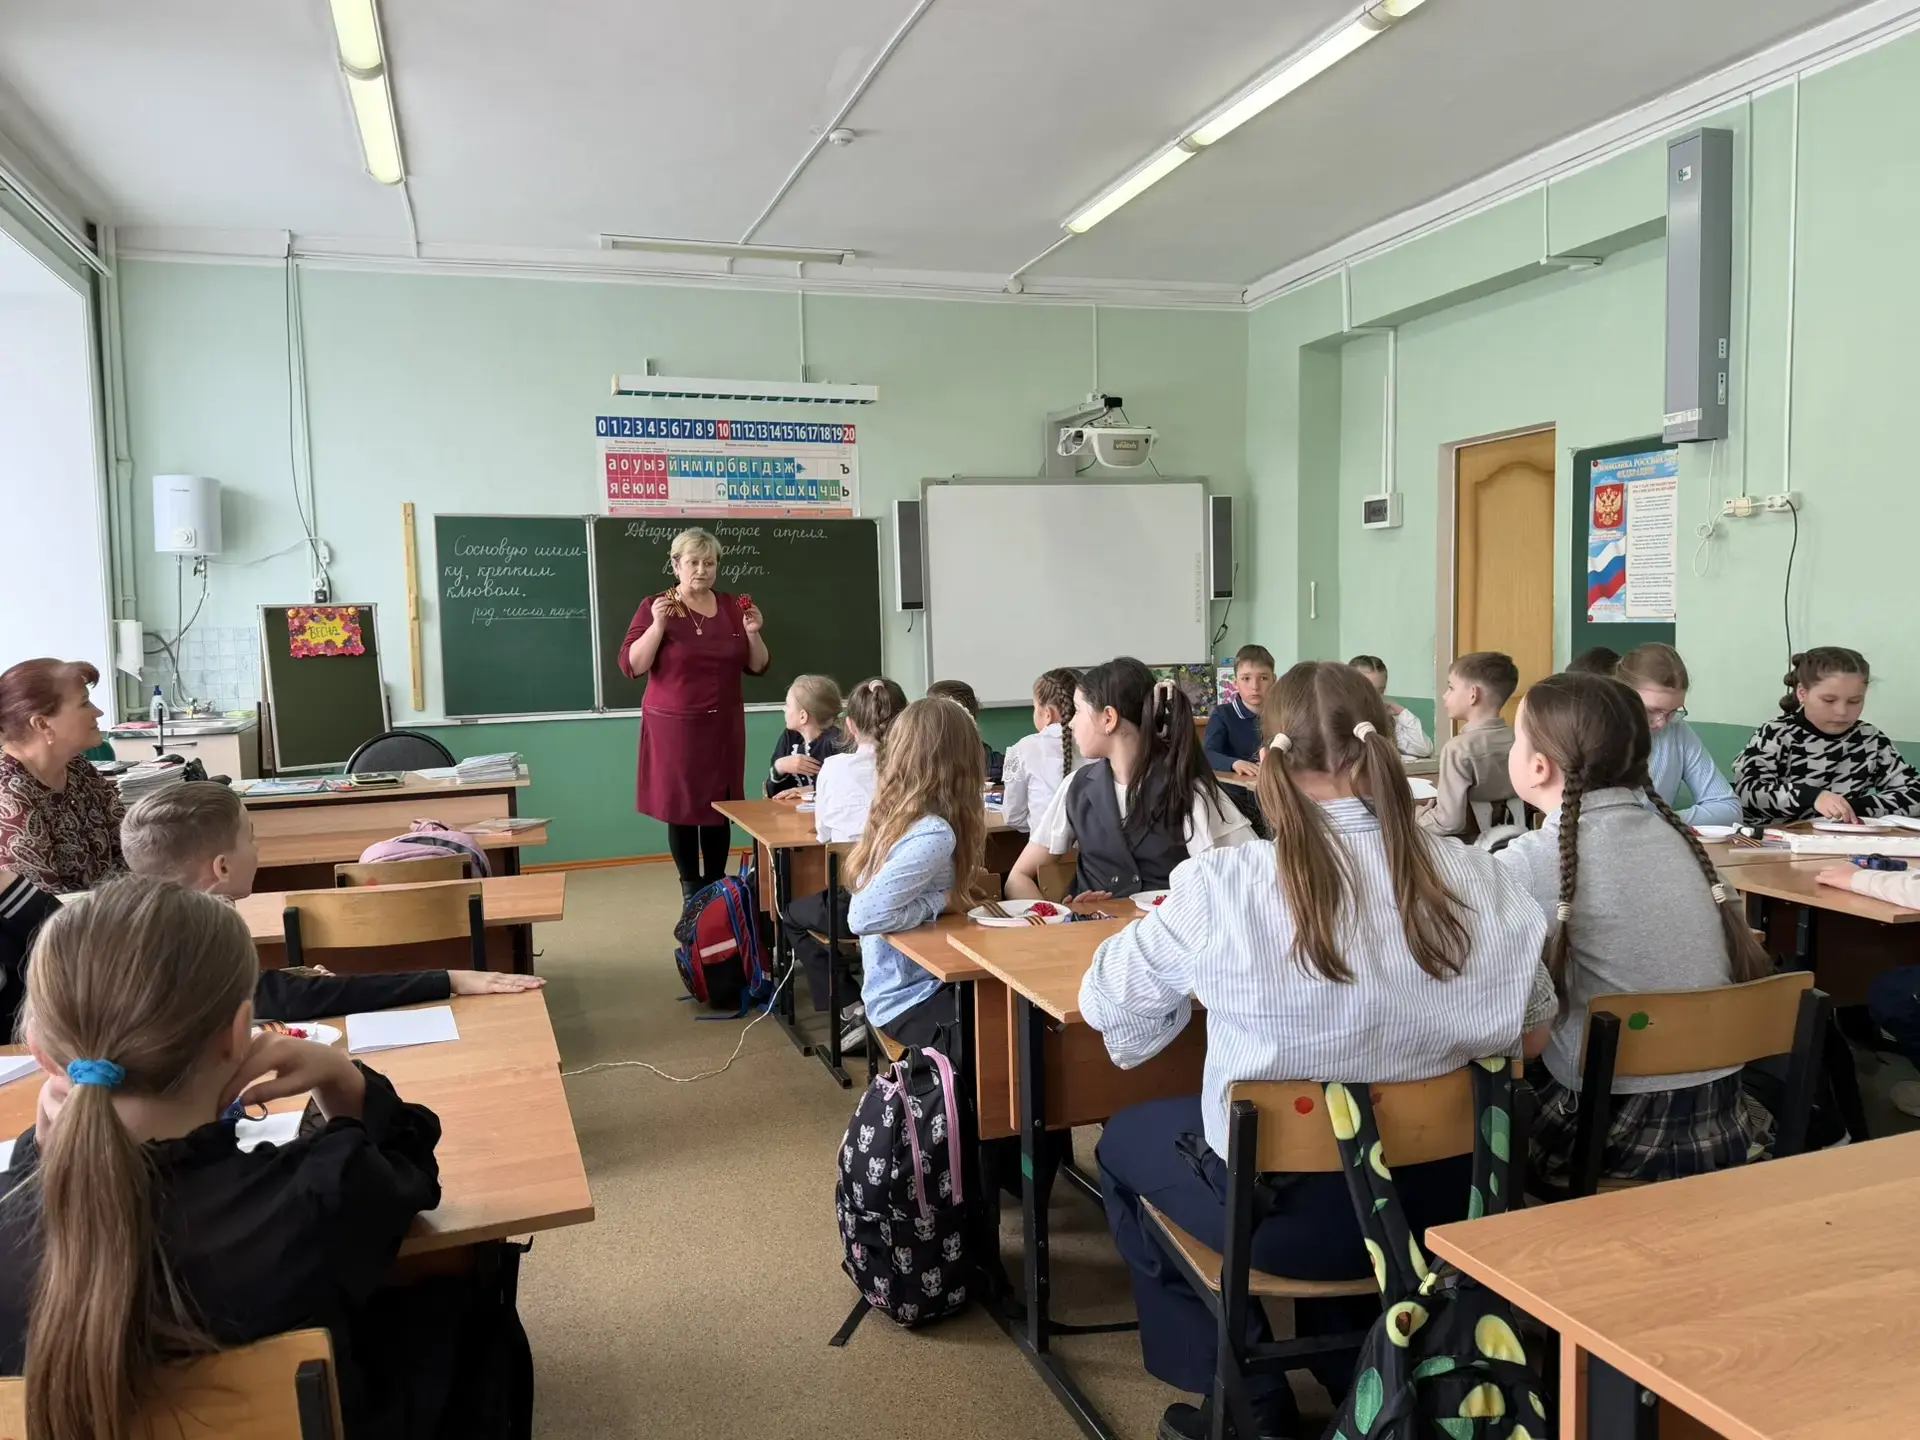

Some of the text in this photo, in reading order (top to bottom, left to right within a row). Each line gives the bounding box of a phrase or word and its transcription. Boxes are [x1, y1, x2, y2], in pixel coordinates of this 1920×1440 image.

[599, 420, 855, 441] 0 1 2 3 4 5 6 7 8 9 10 11 12 13 14 15 16 17 18 19 20
[715, 520, 760, 542] второе
[454, 535, 528, 563] Сосновую
[477, 566, 556, 585] крепким
[309, 626, 338, 639] ВЕСНА
